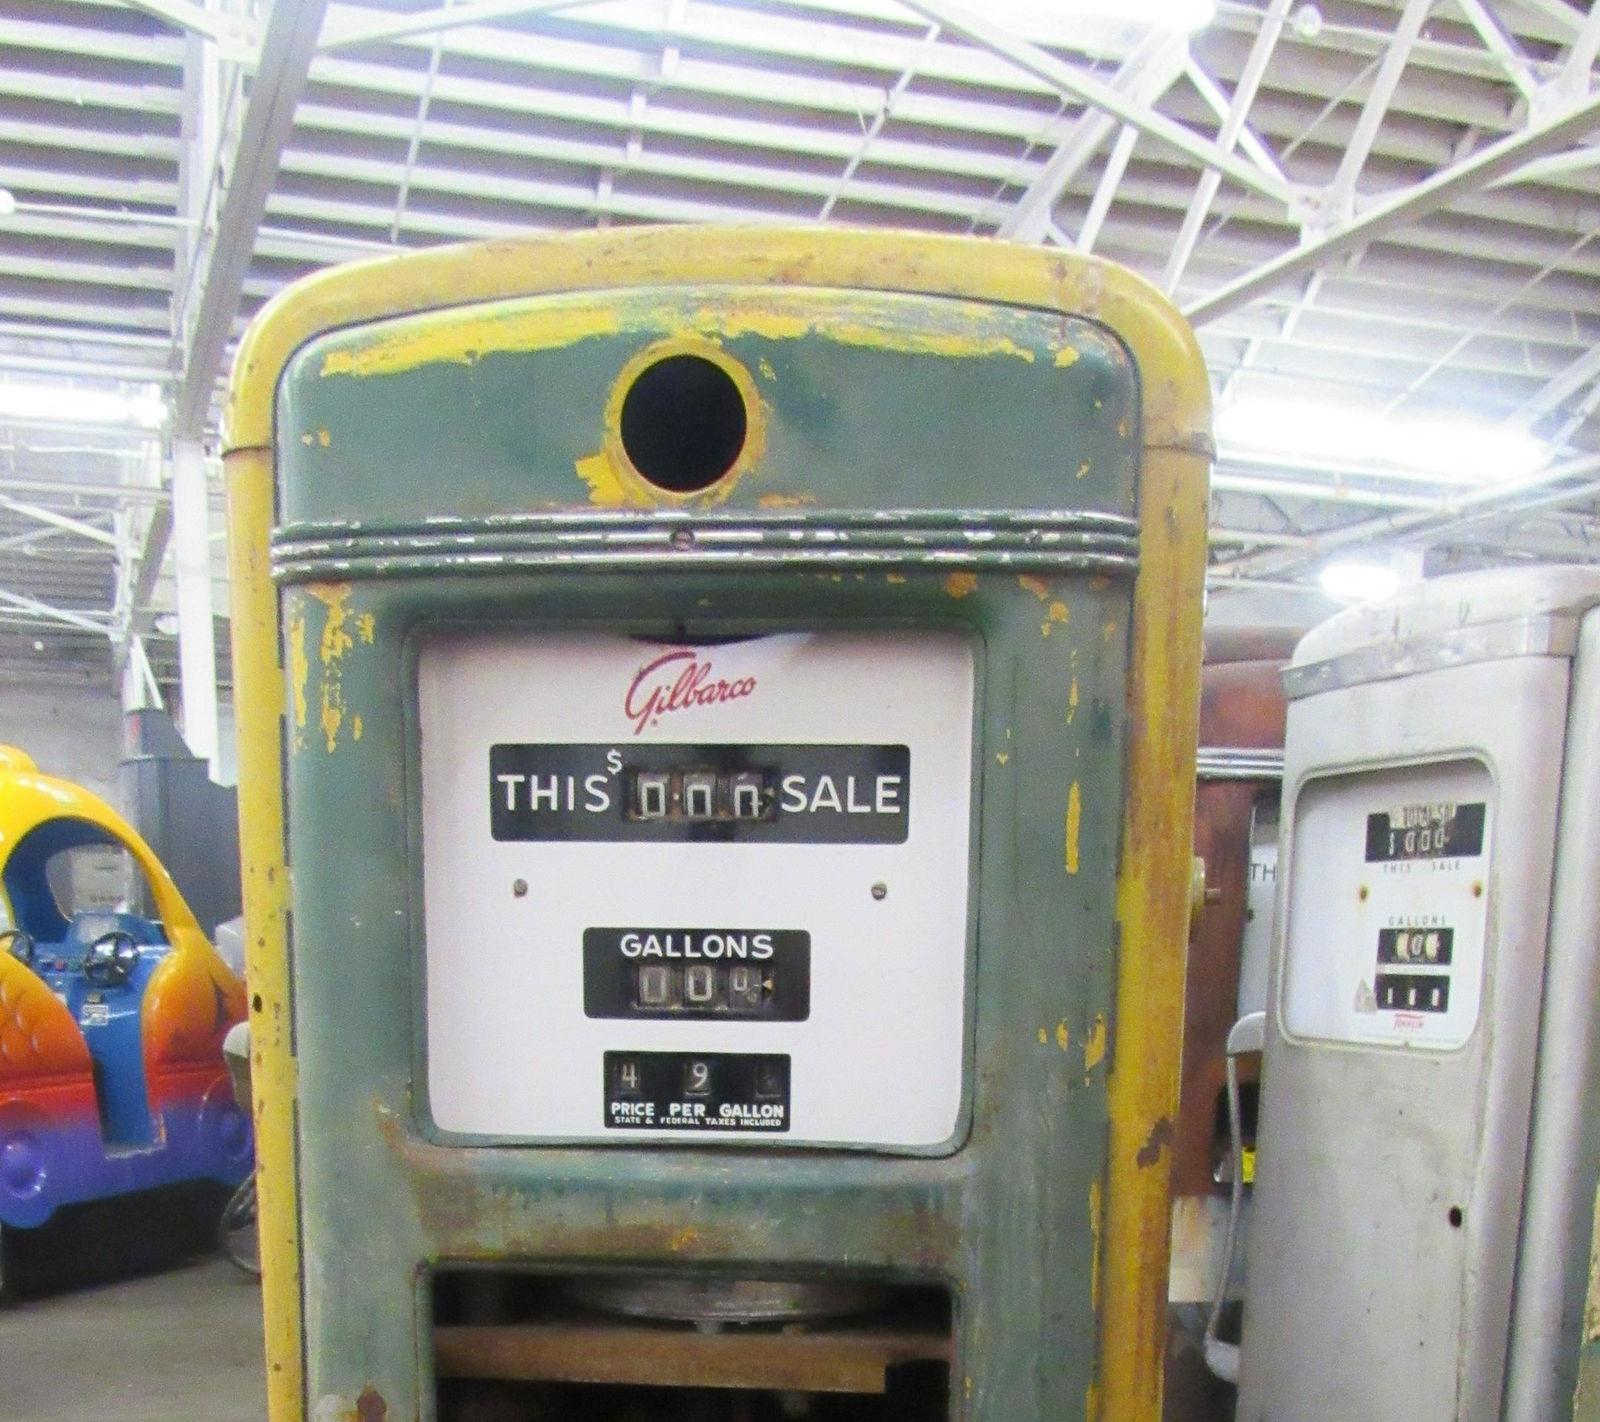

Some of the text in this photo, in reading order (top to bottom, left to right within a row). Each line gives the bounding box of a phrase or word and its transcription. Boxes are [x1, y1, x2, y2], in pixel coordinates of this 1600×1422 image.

[624, 650, 757, 735] Gilbarco
[497, 774, 612, 812] THIS
[607, 749, 622, 775] $
[780, 775, 901, 813] SALE
[620, 934, 774, 959] GALLONS
[621, 1062, 709, 1088] 4 9
[611, 1102, 784, 1119] PRICE PER GALLON
[614, 1116, 641, 1125] STATE
[660, 1117, 700, 1126] FEDERAL
[706, 1117, 736, 1126] TAXES
[740, 1118, 782, 1127] INCLUDED
